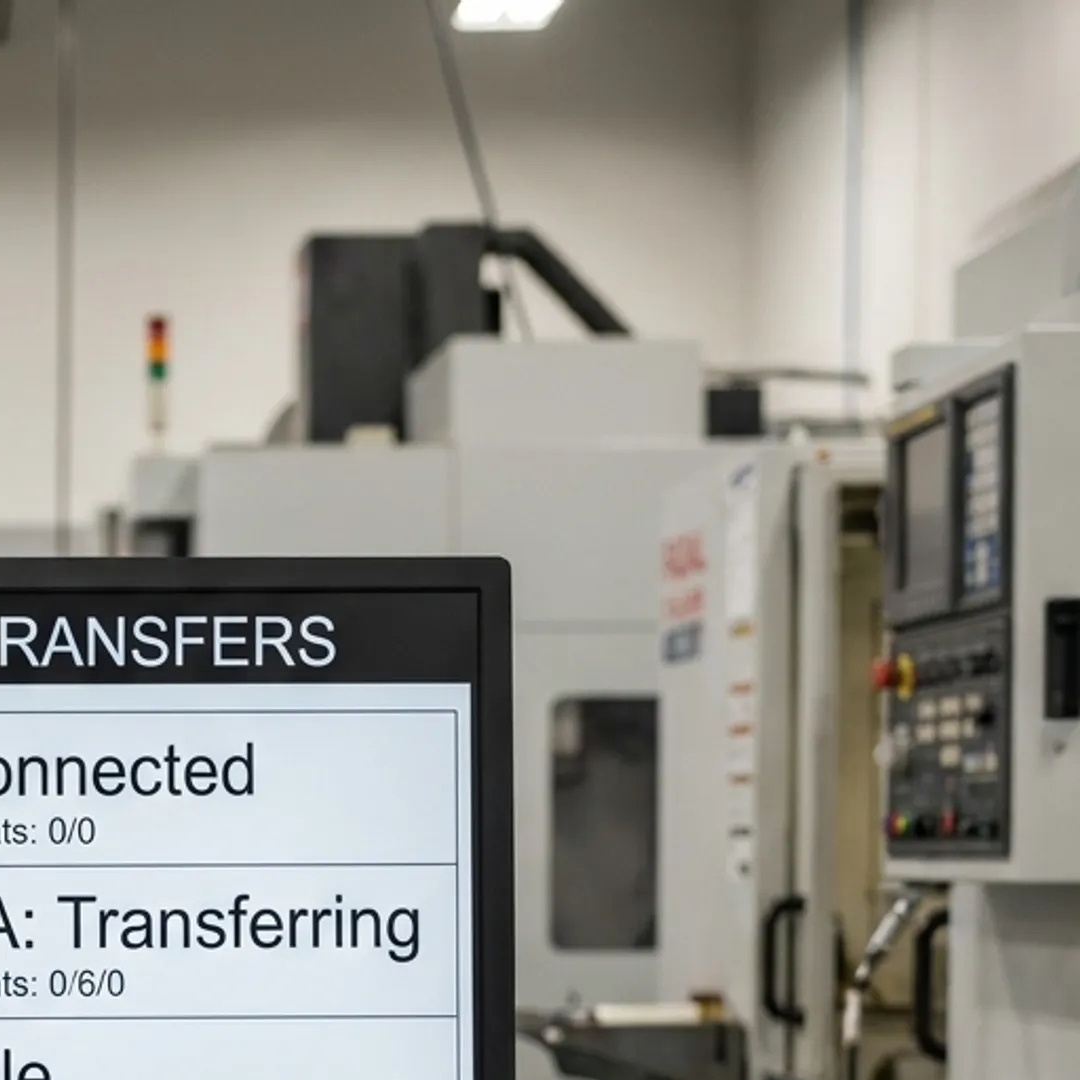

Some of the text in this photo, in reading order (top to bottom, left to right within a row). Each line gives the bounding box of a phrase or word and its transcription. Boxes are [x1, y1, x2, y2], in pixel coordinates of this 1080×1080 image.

[48, 817, 96, 845] 0/0
[57, 894, 419, 963] Transferring
[49, 969, 125, 997] 0/6/0
